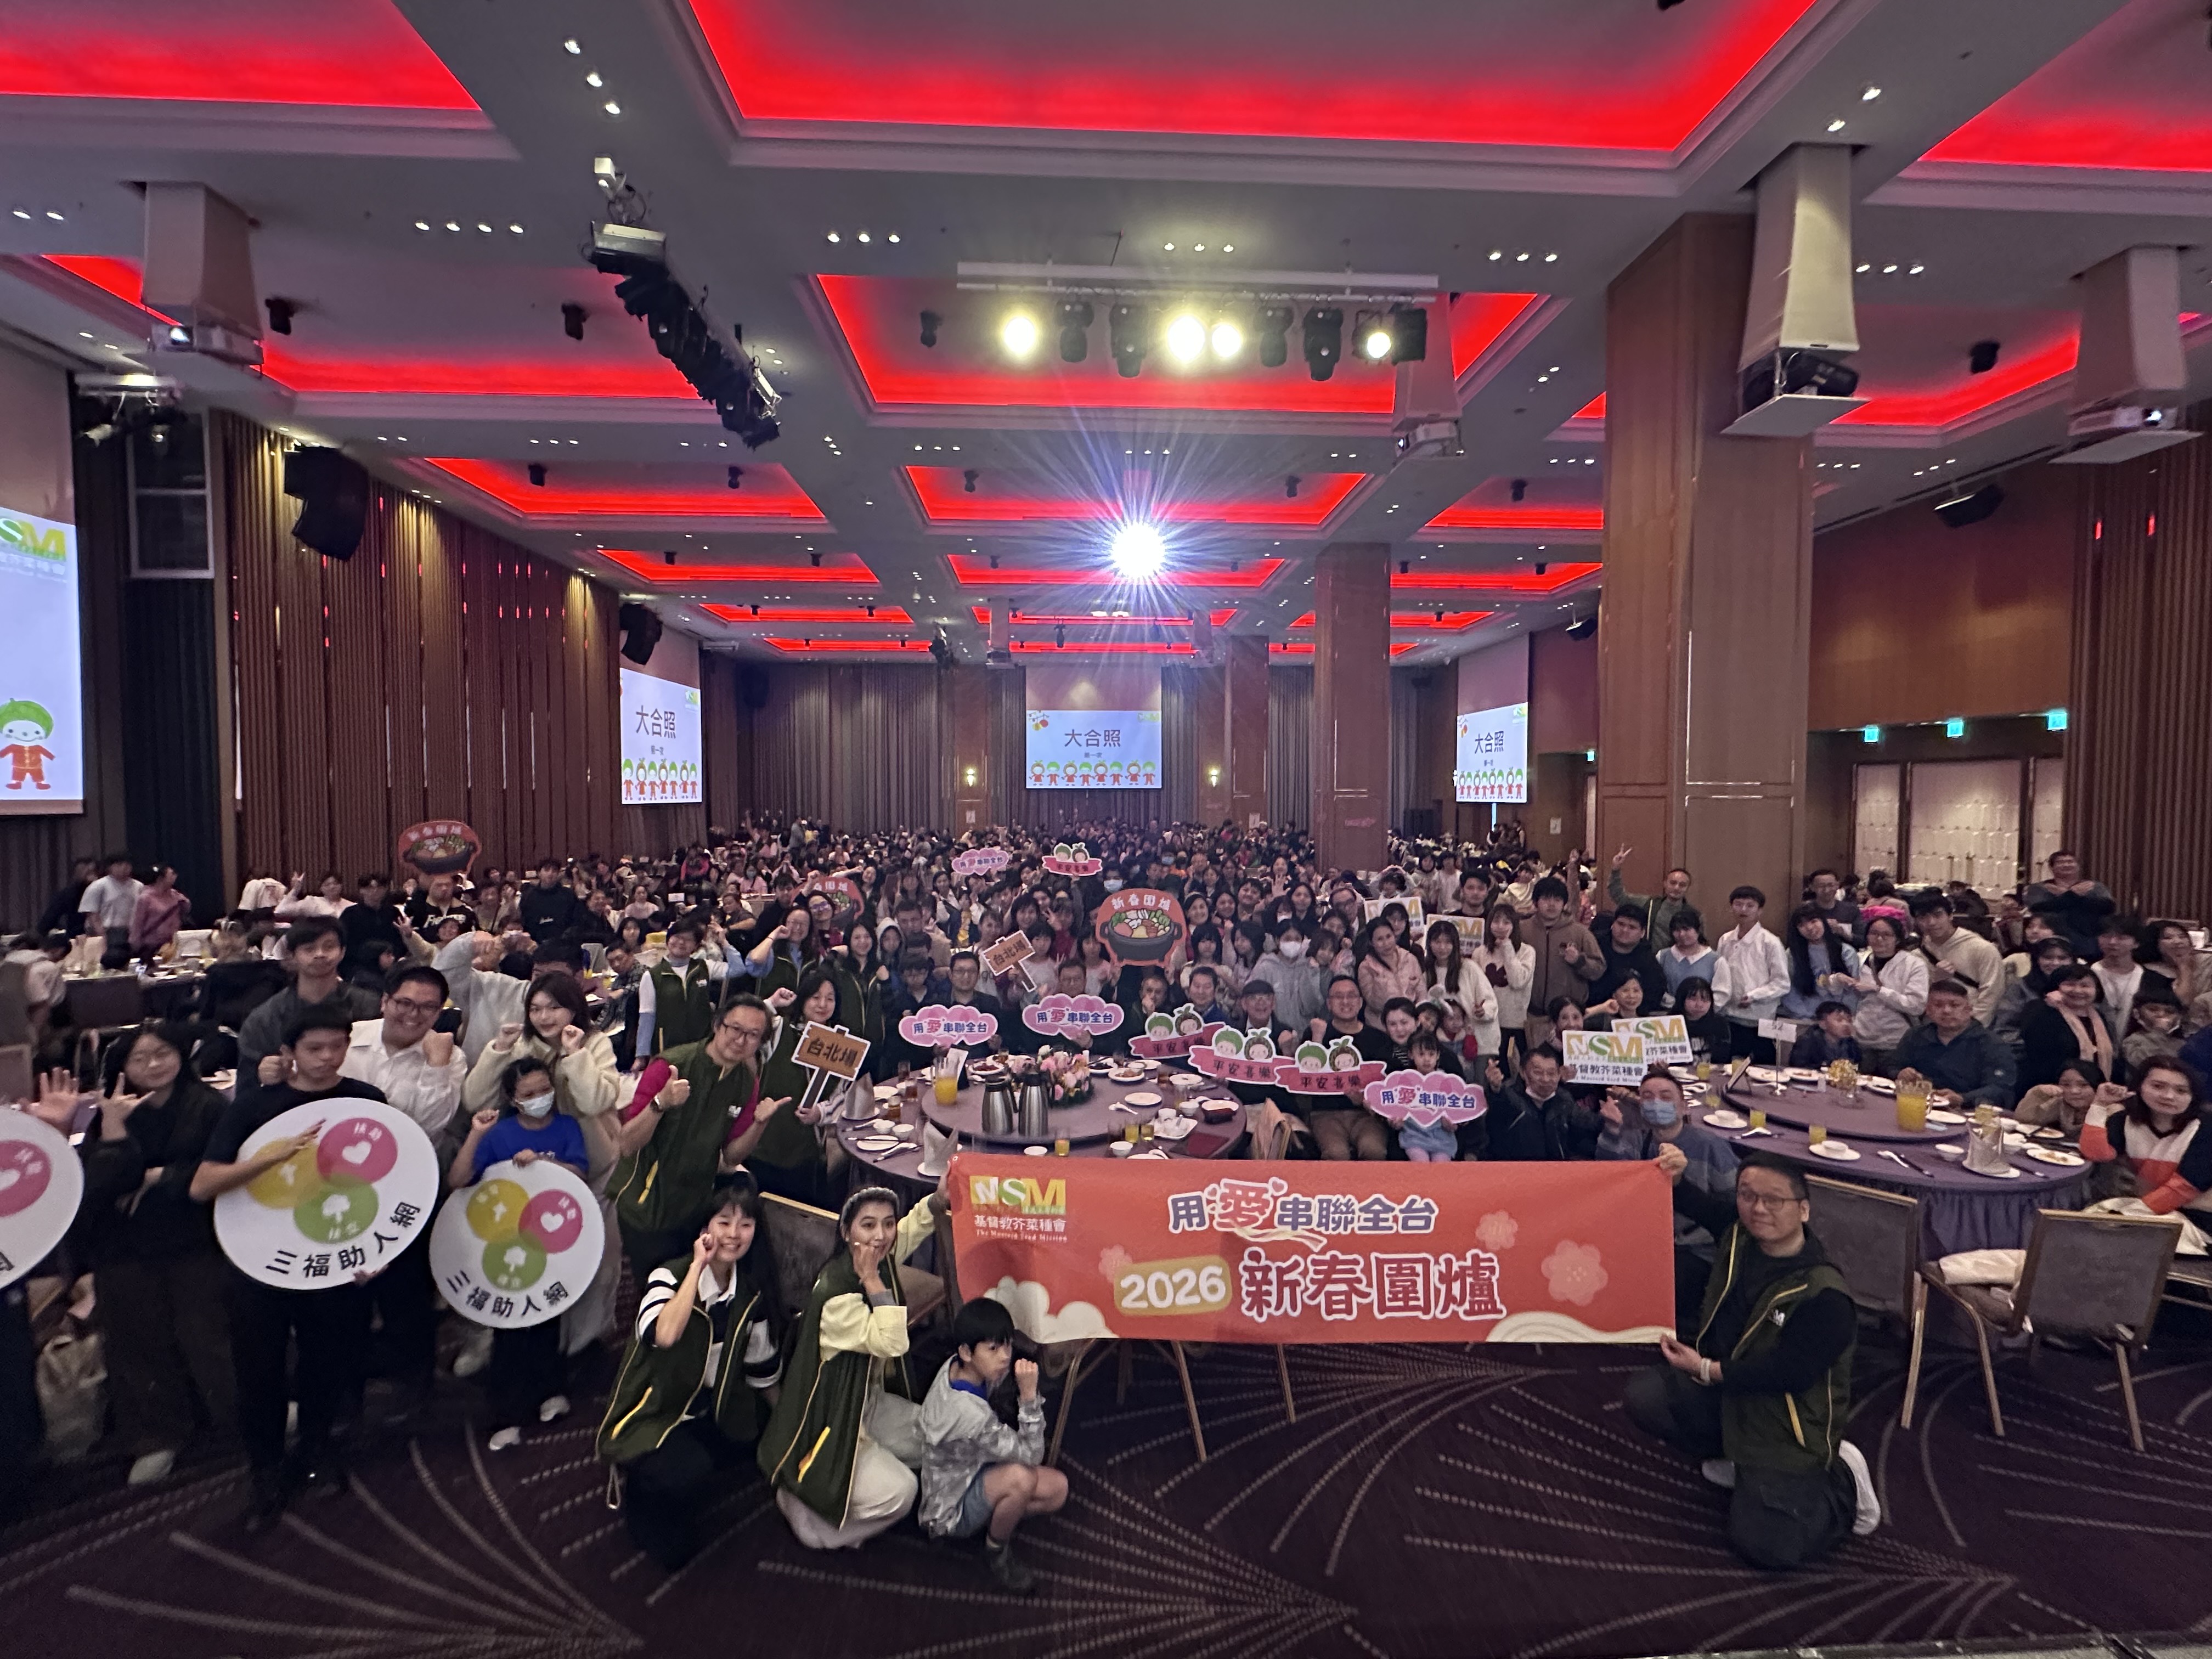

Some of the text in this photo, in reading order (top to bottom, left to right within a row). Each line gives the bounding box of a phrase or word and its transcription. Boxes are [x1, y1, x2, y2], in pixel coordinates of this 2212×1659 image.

[636, 704, 676, 739] 大合照
[1064, 729, 1121, 747] 大合照
[1475, 731, 1504, 754] 大合照
[913, 1018, 987, 1034] 用愛串聯全台
[1037, 1007, 1113, 1023] 用愛串聯全台
[1566, 1035, 1643, 1063] NSM
[1382, 1087, 1475, 1108] 用愛串聯全台
[969, 1175, 1066, 1214] NSM
[1167, 1178, 1438, 1233] 用愛串聯全台
[974, 1215, 1066, 1232] 基督教芥菜種會
[266, 1201, 421, 1278] 三福助人網
[1120, 1246, 1506, 1322] 2026 新春圍爐
